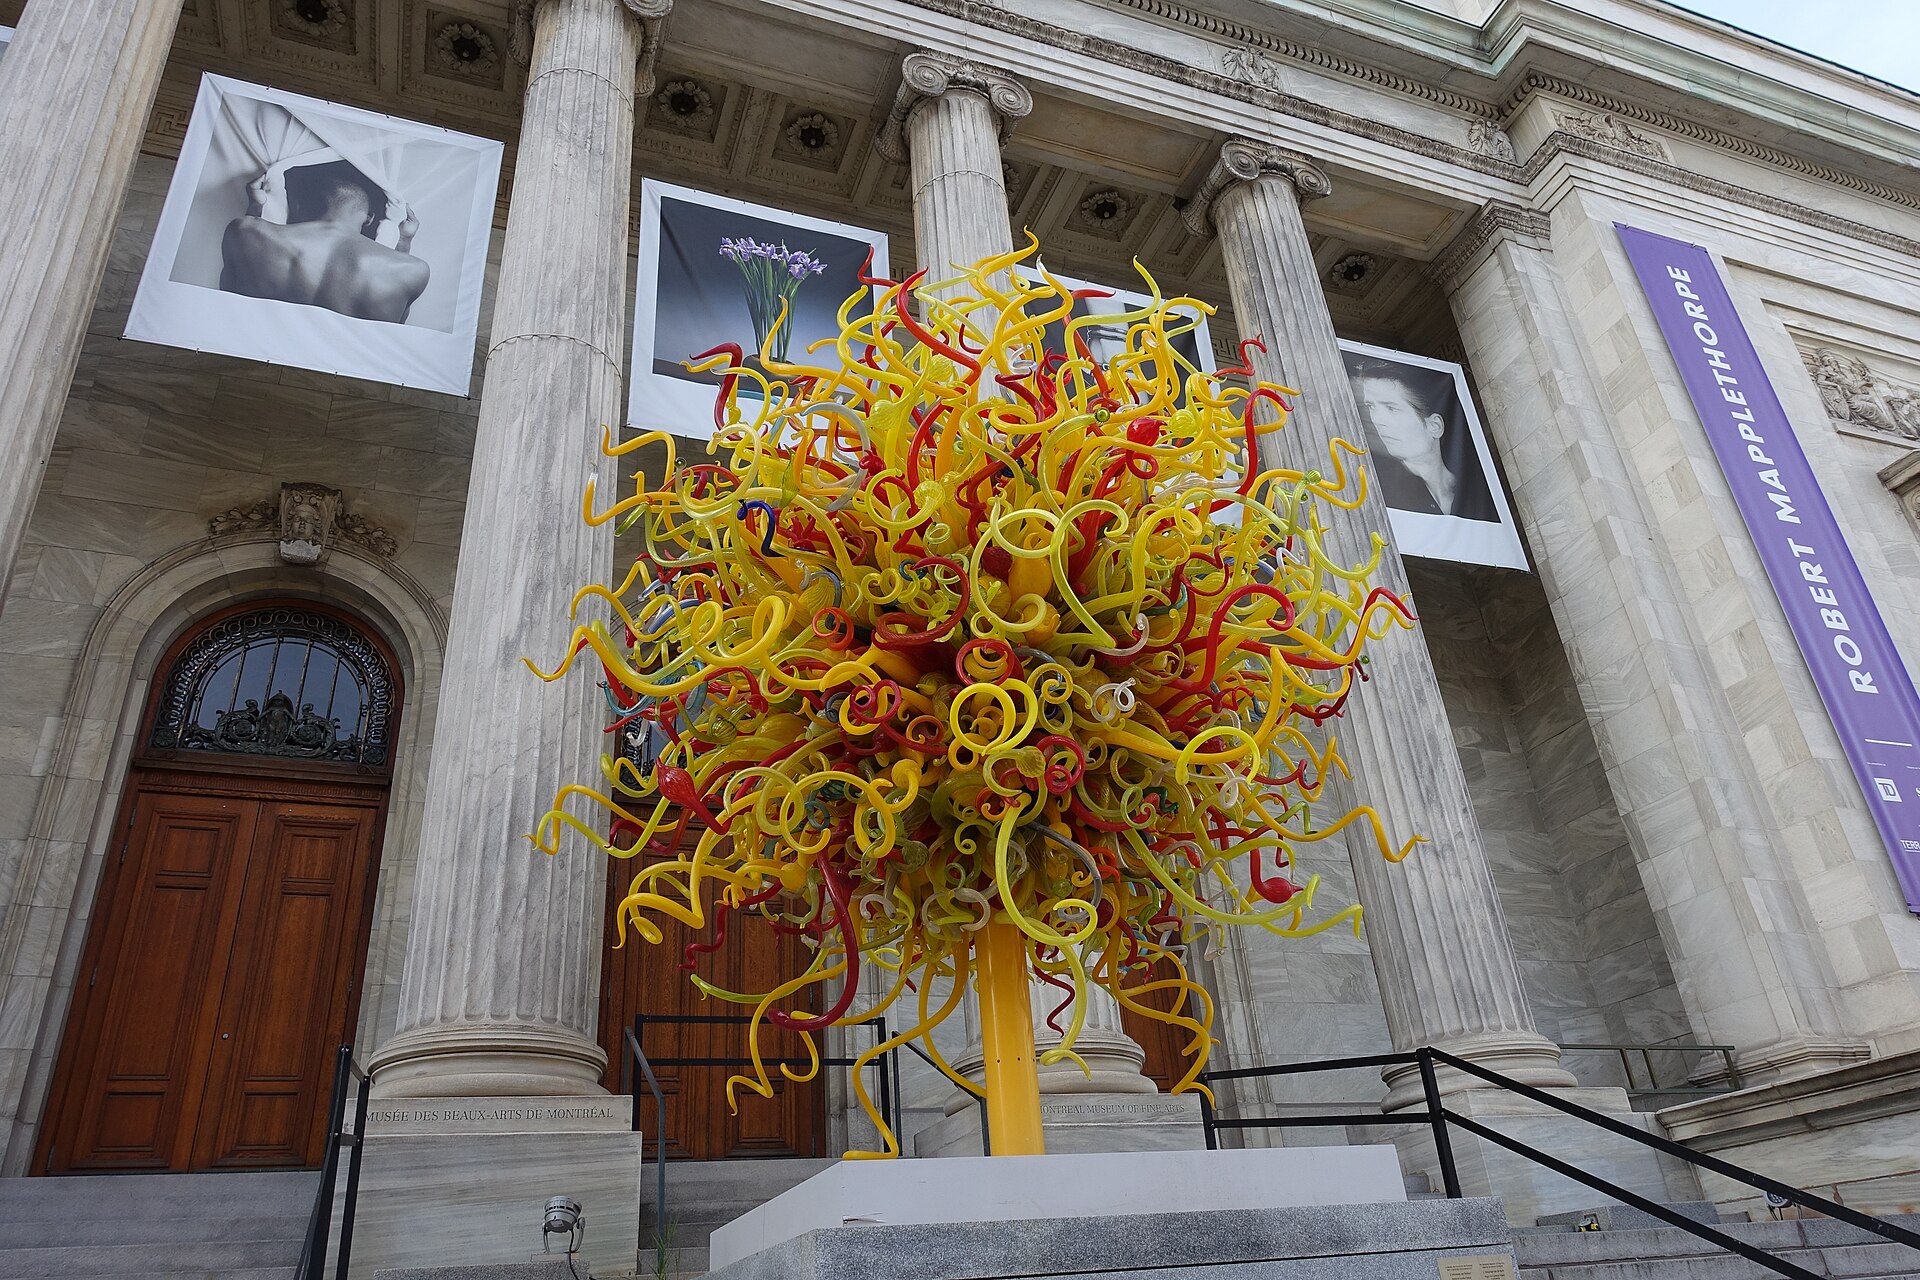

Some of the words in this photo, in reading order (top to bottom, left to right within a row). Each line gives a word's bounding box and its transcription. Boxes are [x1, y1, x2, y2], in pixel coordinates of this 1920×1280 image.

[1666, 264, 1802, 525] MAPPLETHORPE
[1788, 537, 1879, 695] ROBERT
[1900, 839, 1920, 850] TERR
[366, 1109, 409, 1122] MUSÉE
[414, 1110, 439, 1121] DES
[443, 1109, 522, 1121] BEAUX-ARTS
[526, 1109, 542, 1119] DE
[547, 1106, 613, 1118] MONTRÉAL
[1087, 1104, 1125, 1114] MUSEUM
[1127, 1104, 1138, 1113] OF
[1141, 1104, 1160, 1113] FINE
[1164, 1104, 1185, 1113] ARTS
